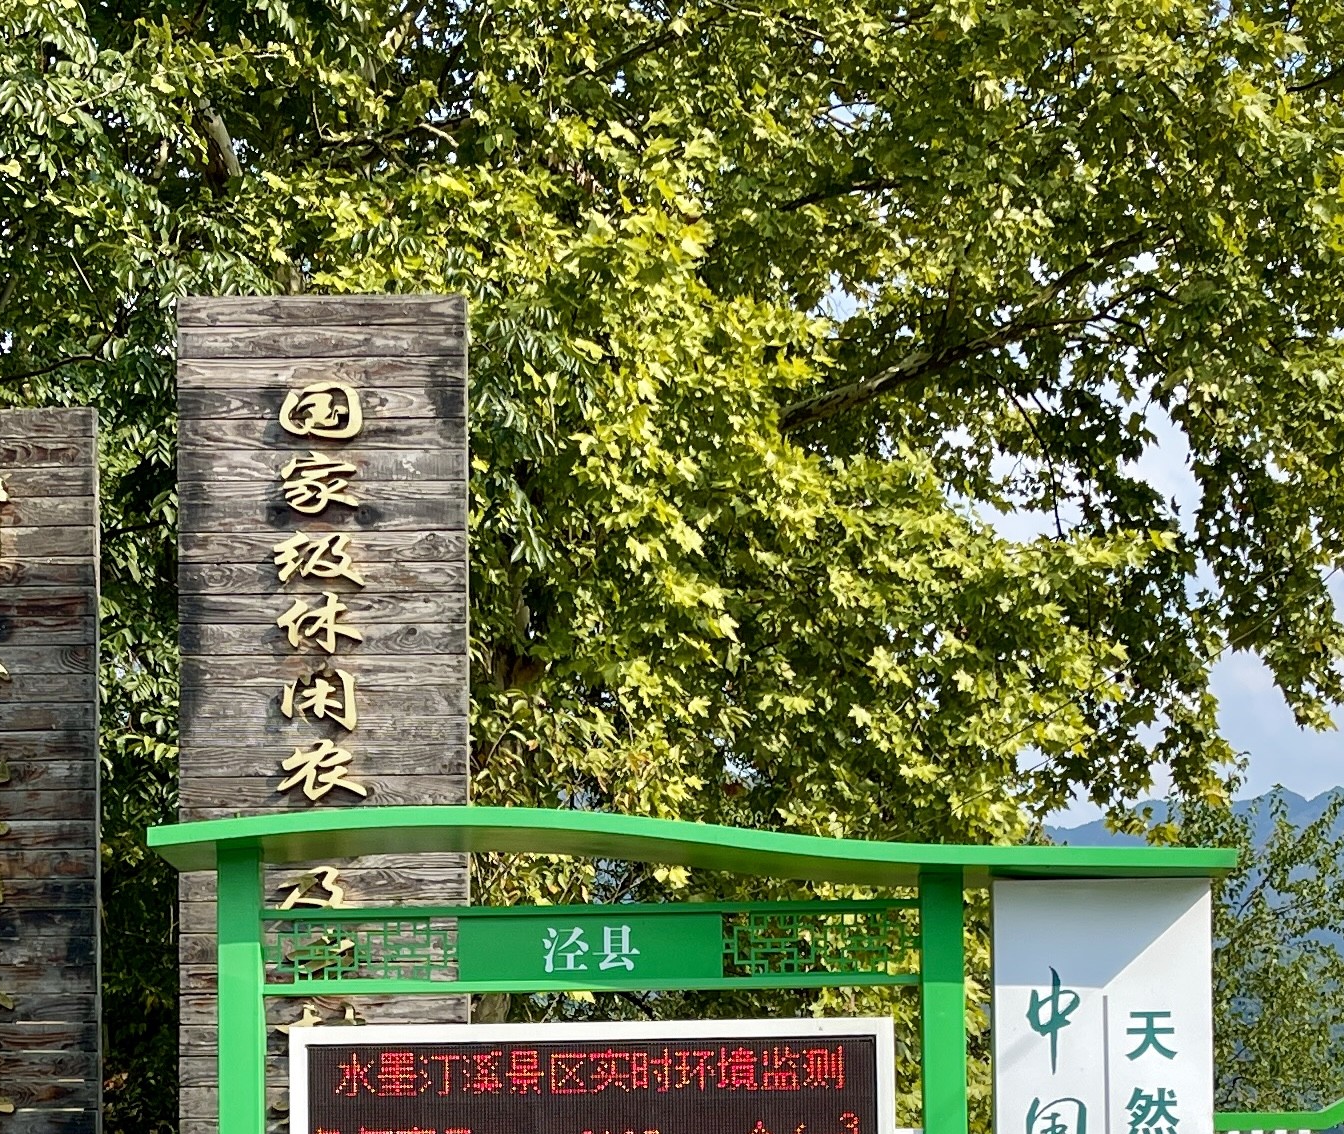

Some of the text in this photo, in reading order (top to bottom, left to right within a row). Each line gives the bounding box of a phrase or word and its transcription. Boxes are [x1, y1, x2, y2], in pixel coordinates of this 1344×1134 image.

[542, 925, 641, 973] 泾县
[335, 1046, 846, 1097] 水墨汀溪景区实时环境监测
